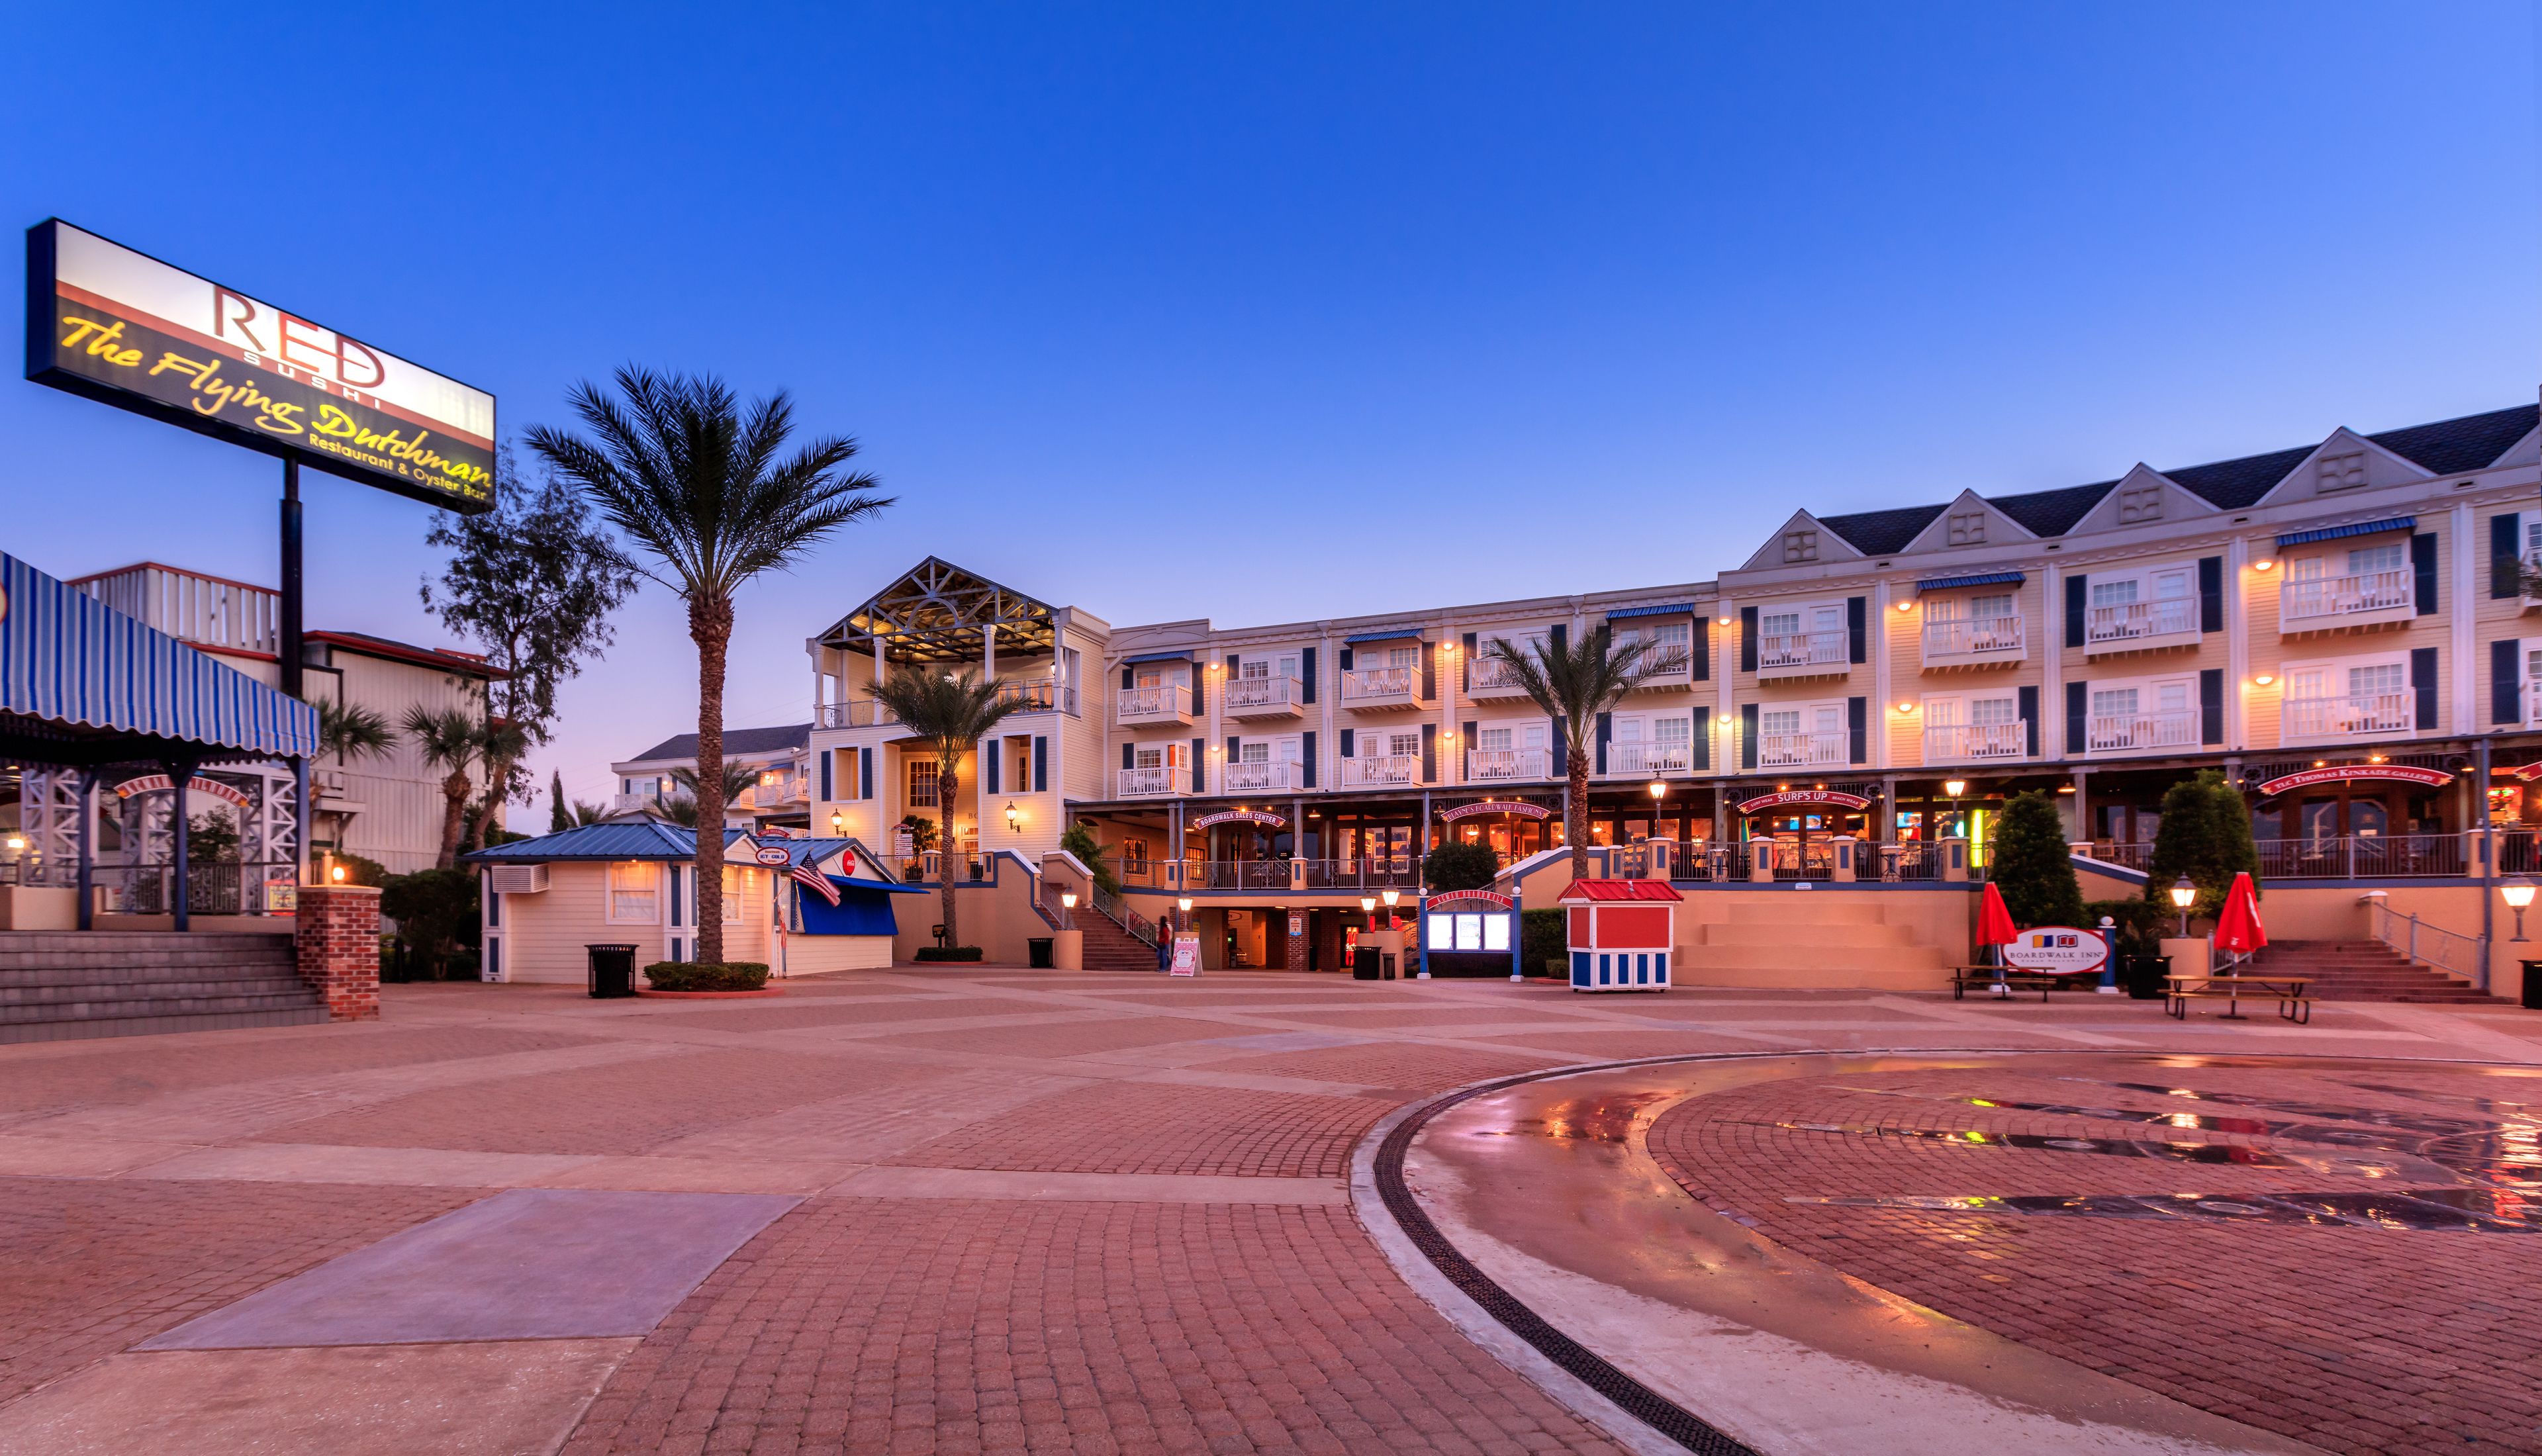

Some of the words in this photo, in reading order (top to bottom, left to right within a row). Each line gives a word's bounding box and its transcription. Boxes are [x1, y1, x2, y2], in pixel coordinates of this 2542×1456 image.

[213, 285, 385, 388] RED
[243, 351, 381, 410] SUSHI
[62, 316, 144, 366] The
[148, 352, 305, 435] Flying
[311, 404, 492, 488] Dutchman
[308, 433, 395, 471] Restaurant
[398, 463, 409, 477] &
[413, 468, 461, 492] Oyster
[2275, 780, 2293, 790] TLC
[2293, 771, 2338, 784] THOMAS
[2339, 768, 2390, 777] KINKADE
[2391, 770, 2435, 782] GALLERY
[1777, 791, 1811, 802] SURF'S
[1813, 792, 1828, 801] UP
[1200, 813, 1234, 826] BOARDWALK
[1254, 813, 1276, 823] CENTER
[1447, 806, 1475, 820] BLAYNE'S
[1515, 805, 1543, 817] FASHIONS
[1436, 891, 1459, 903] KEMAH
[1462, 891, 1504, 903] BOARDWALK
